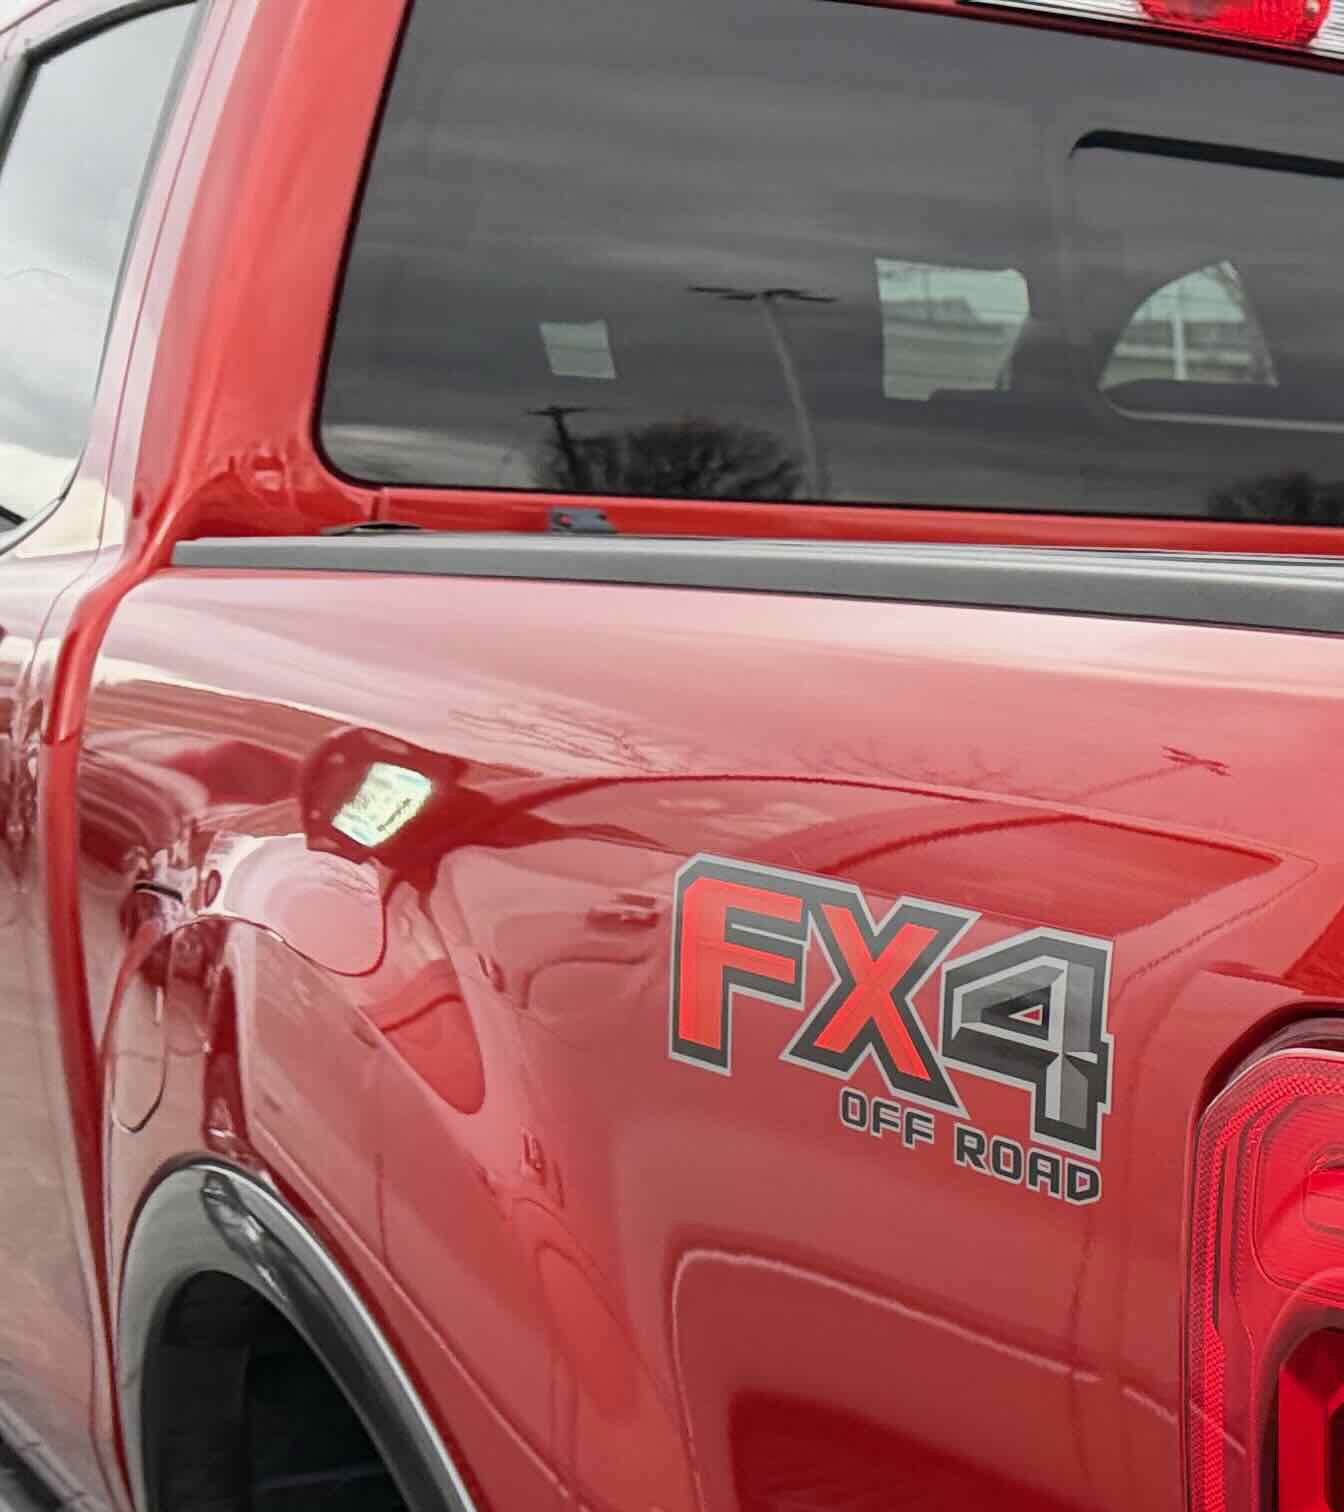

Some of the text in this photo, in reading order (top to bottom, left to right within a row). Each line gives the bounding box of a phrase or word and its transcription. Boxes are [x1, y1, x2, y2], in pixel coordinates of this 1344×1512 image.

[669, 853, 1113, 1160] FX4
[841, 1088, 1101, 1205] OFF ROAD
